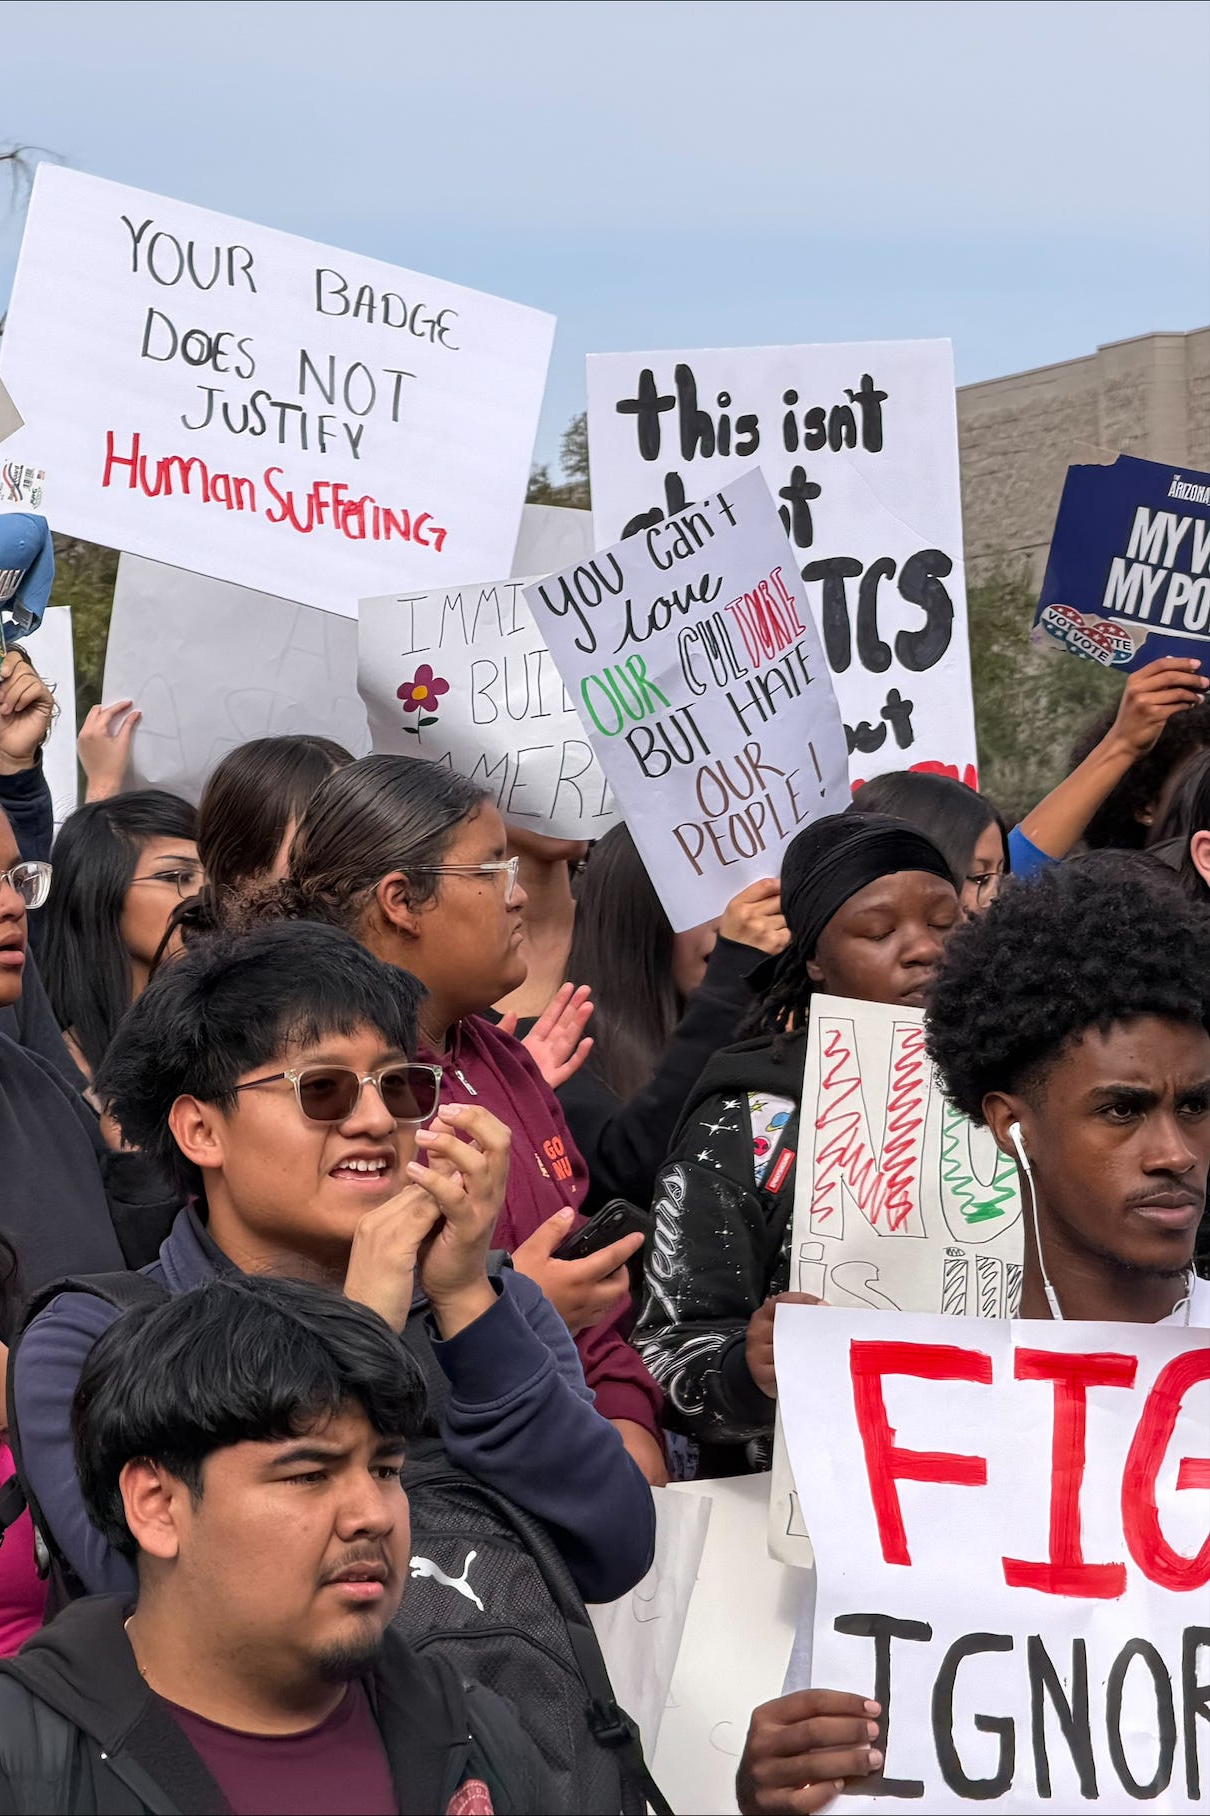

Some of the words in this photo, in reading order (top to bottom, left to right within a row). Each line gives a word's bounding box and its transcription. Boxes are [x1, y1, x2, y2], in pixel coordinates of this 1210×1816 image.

[121, 214, 257, 294] YOUR
[315, 268, 461, 351] BADGE
[140, 306, 256, 380] DOES
[298, 348, 417, 423] NOT
[181, 384, 364, 460] JUSTIFY
[615, 363, 760, 462] this
[101, 430, 257, 513] Human
[1126, 506, 1194, 569] MY
[397, 583, 526, 657] IMMI
[612, 573, 724, 655] love
[1102, 557, 1170, 620] MY
[580, 654, 672, 737] OUR
[677, 566, 807, 696] CULTURE
[1073, 632, 1110, 662] VOTE
[624, 702, 711, 778] BUT
[725, 640, 816, 737] HATE
[695, 741, 786, 818] OUR
[543, 1136, 566, 1161] GO
